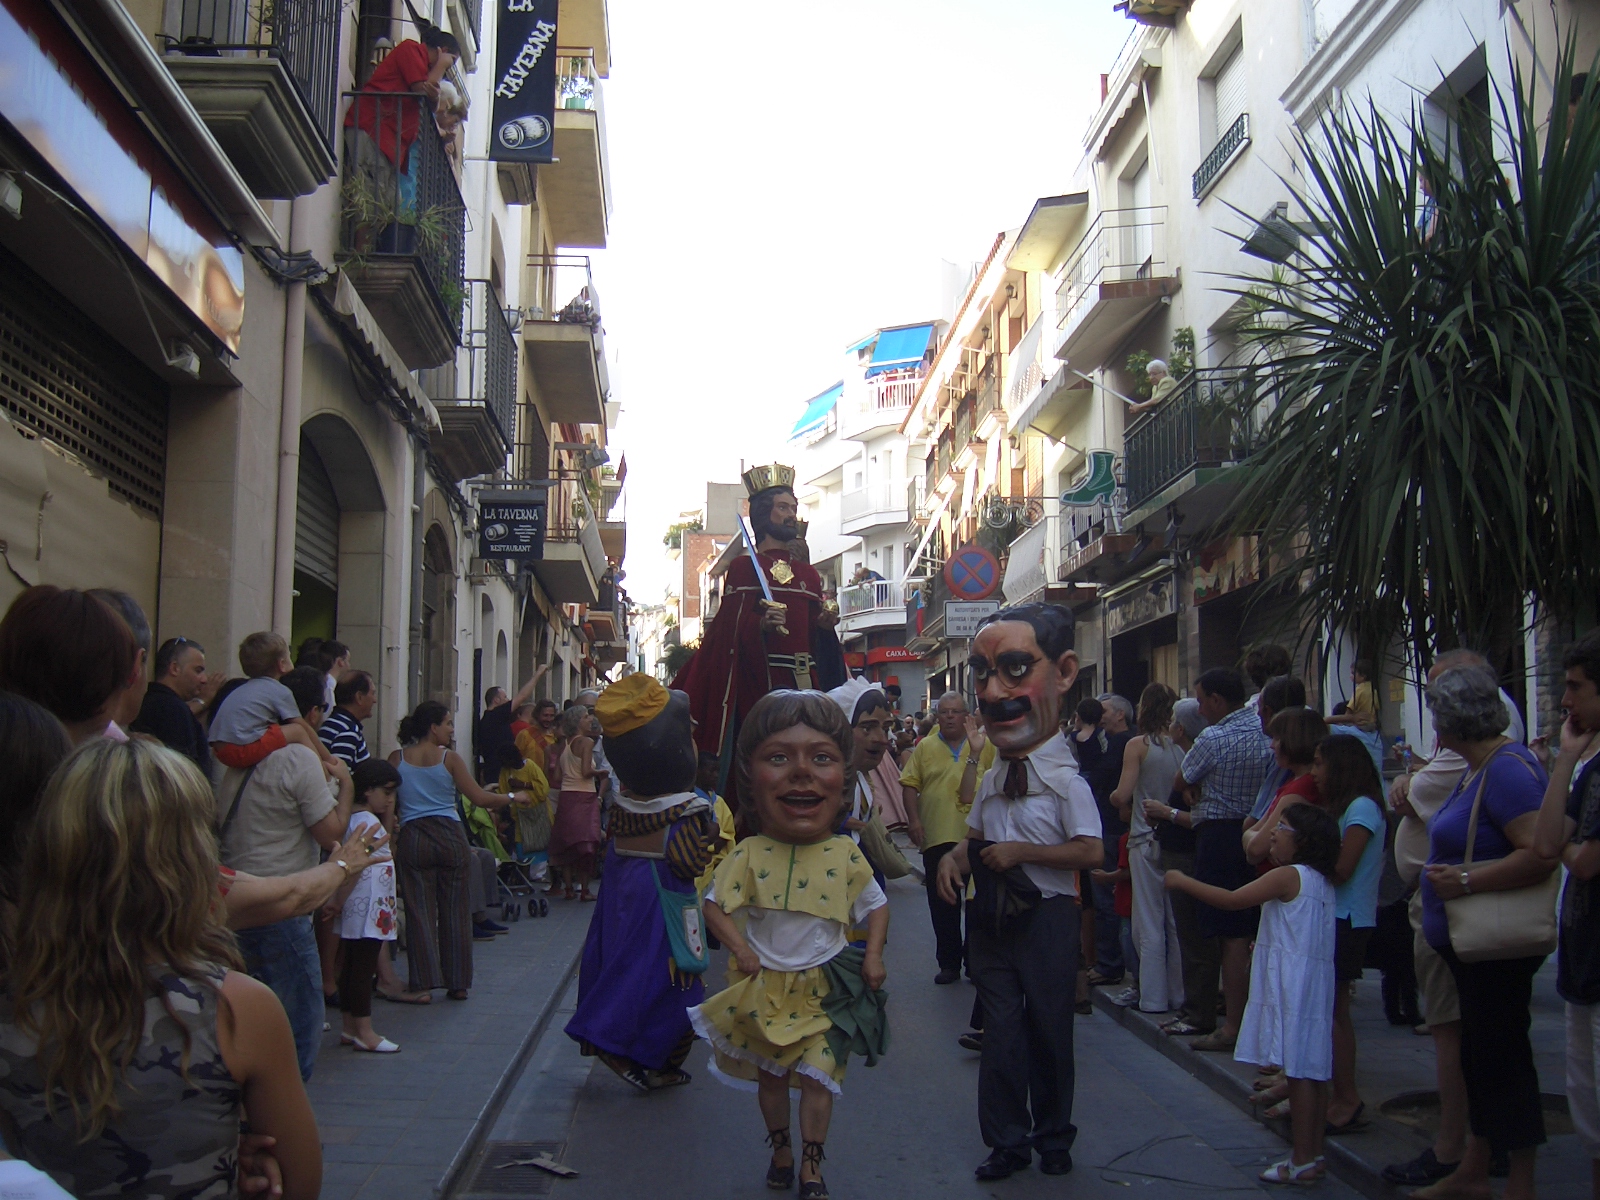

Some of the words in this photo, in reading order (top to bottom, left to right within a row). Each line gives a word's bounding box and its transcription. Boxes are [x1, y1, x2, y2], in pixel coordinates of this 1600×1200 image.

[508, 0, 534, 12] LA
[495, 20, 556, 99] TAVERNA
[484, 508, 496, 520] LA
[498, 508, 539, 520] TAVERNA
[490, 544, 531, 552] RESTAURANT
[885, 650, 907, 658] CAIXA
